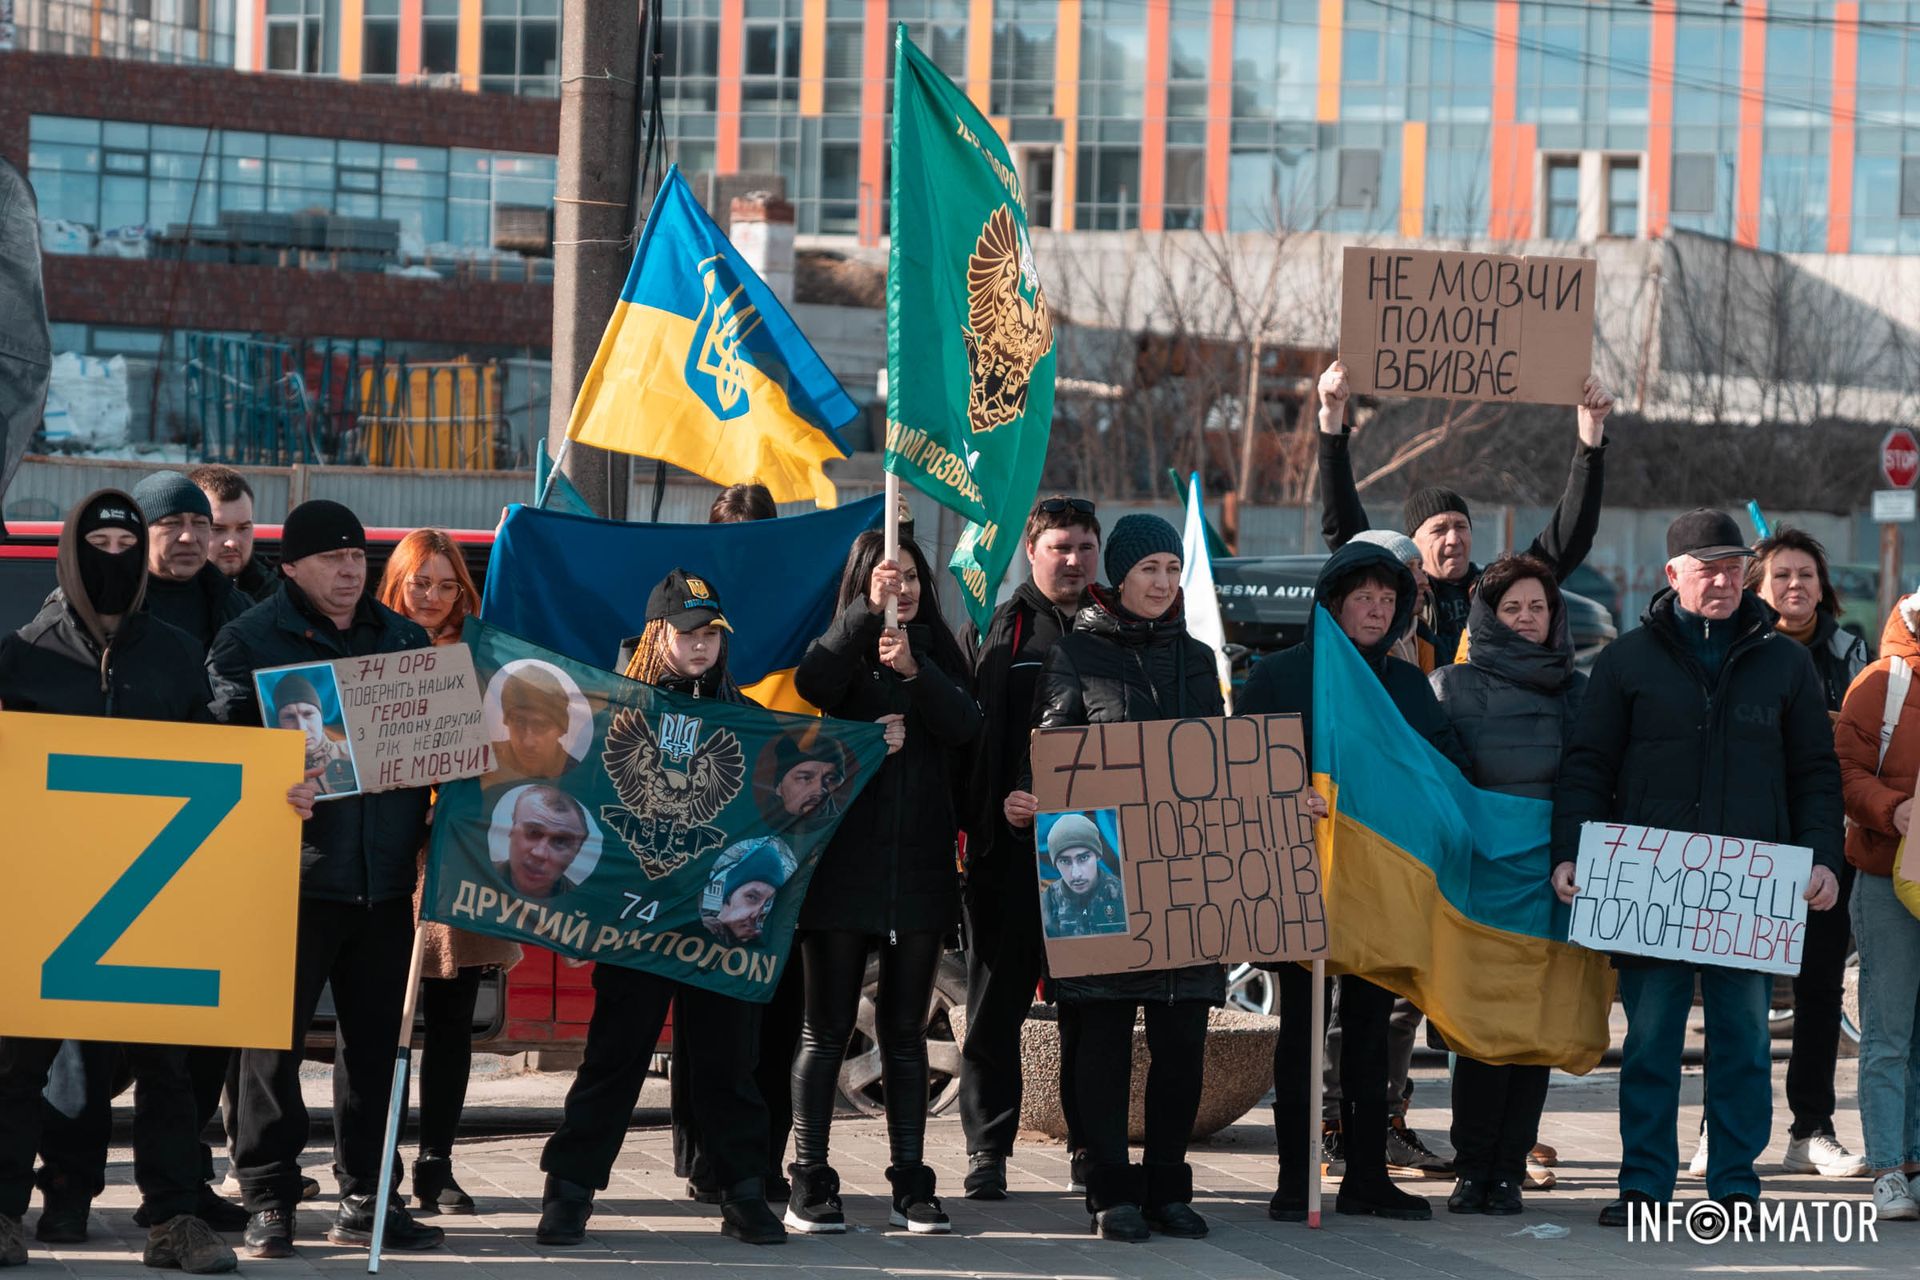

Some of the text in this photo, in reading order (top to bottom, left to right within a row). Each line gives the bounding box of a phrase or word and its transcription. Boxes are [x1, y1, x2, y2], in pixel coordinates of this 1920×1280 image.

[1368, 256, 1582, 312] НЕ МОВЧИ
[1381, 305, 1499, 346] ПОЛОН
[1375, 348, 1519, 396] ВБИВАЄ
[1886, 449, 1918, 470] STOP
[1215, 584, 1268, 597] DESNA
[358, 652, 437, 682] 74 ОРБ
[418, 674, 465, 697] НАШИХ
[357, 709, 482, 741] З ПОЛОНУ ДРУГИЙ
[371, 698, 428, 723] ГЕРОЇВ
[375, 727, 463, 757] РІК НЕВОЛІ
[1040, 714, 1306, 807] 74 ОРБ
[379, 744, 490, 785] НЕ МОВЧИ!
[1604, 824, 1778, 878] 74 ОРБ
[40, 752, 243, 1007] Z
[1136, 845, 1318, 911] ГЕРОЇВ
[1585, 858, 1796, 920] НЕ МОВЧИ
[451, 879, 591, 950] ДРУГИЙ
[619, 891, 660, 924] 74
[1128, 894, 1327, 969] З ПОЛОНУ
